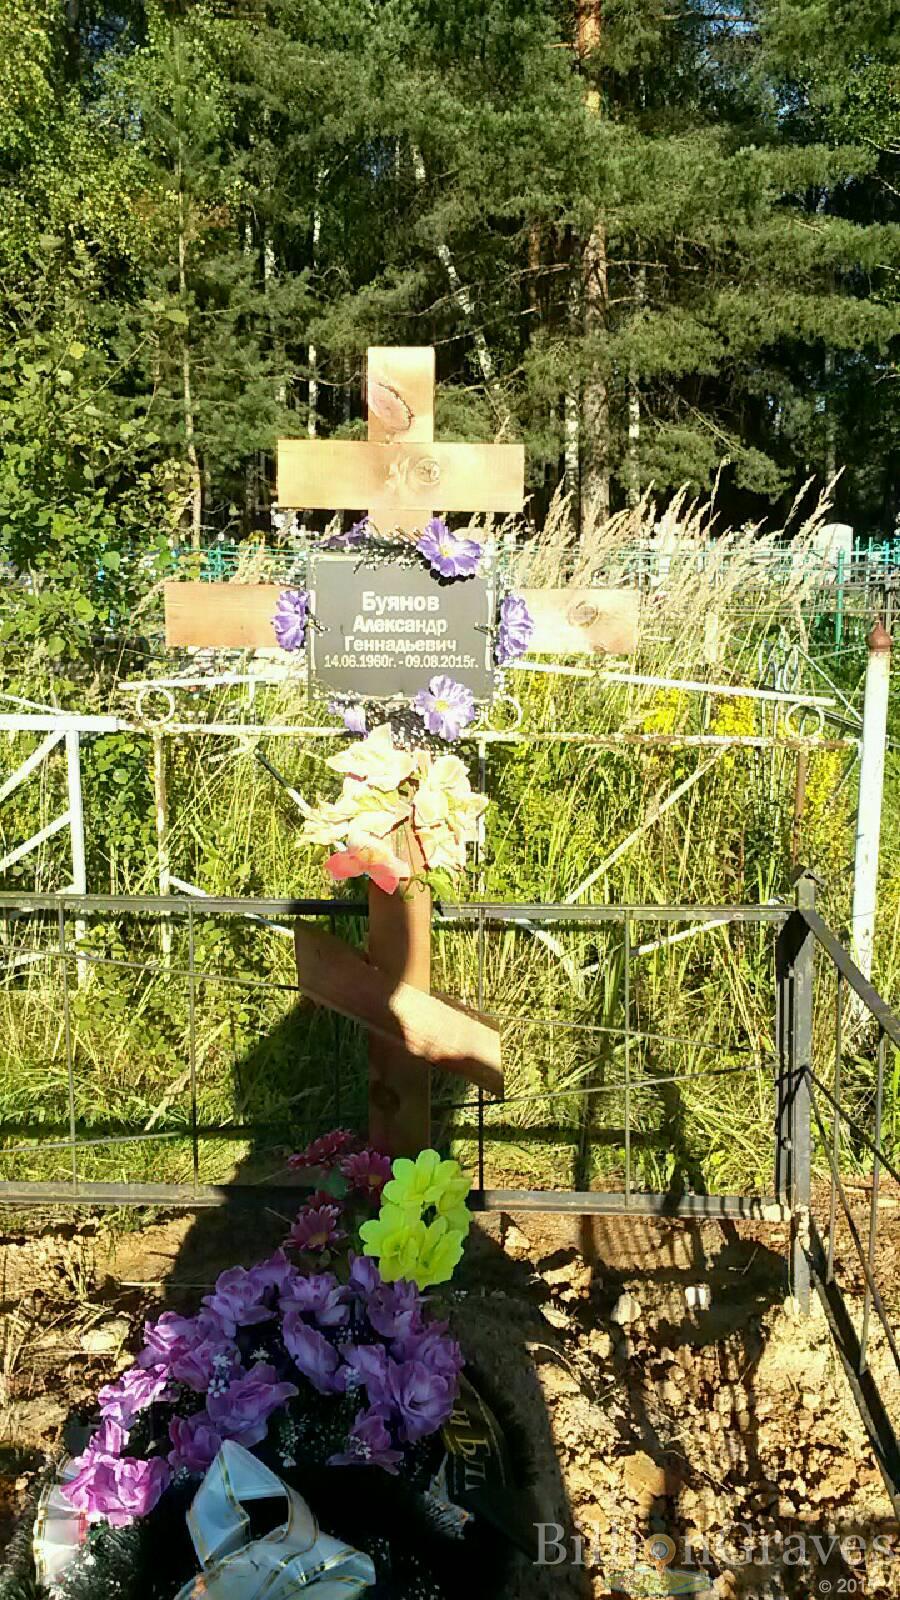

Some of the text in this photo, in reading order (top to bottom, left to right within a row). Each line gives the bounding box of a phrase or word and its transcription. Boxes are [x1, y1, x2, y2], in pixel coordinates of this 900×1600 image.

[362, 591, 440, 615] Буянов
[353, 615, 447, 636] Александр
[344, 636, 457, 653] Геннадьевич
[324, 655, 397, 668] 14.06.1960г.
[405, 655, 479, 668] 09.08.2015г.
